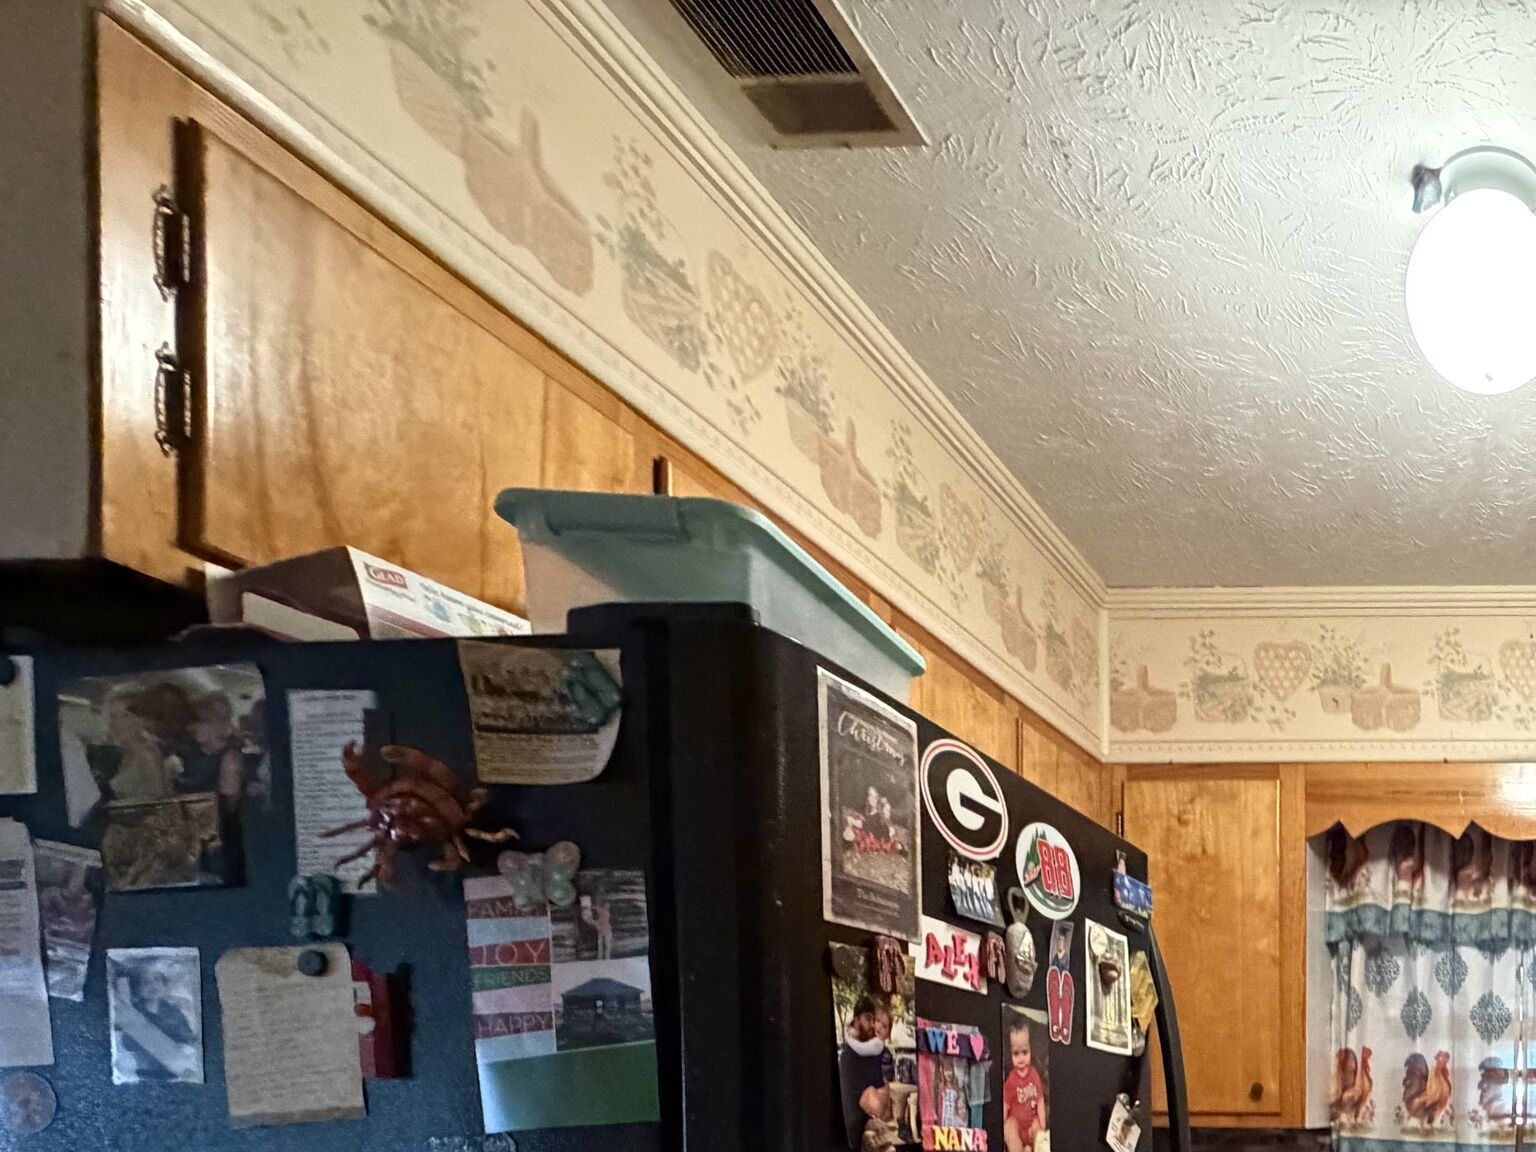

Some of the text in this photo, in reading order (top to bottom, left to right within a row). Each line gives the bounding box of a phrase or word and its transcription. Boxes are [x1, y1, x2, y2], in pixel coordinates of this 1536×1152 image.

[369, 566, 405, 585] GLAD
[1037, 838, 1075, 899] 88
[479, 940, 548, 964] JOY
[477, 1013, 549, 1037] HAPPY
[926, 1027, 960, 1055] WE
[932, 1124, 988, 1152] NANA
